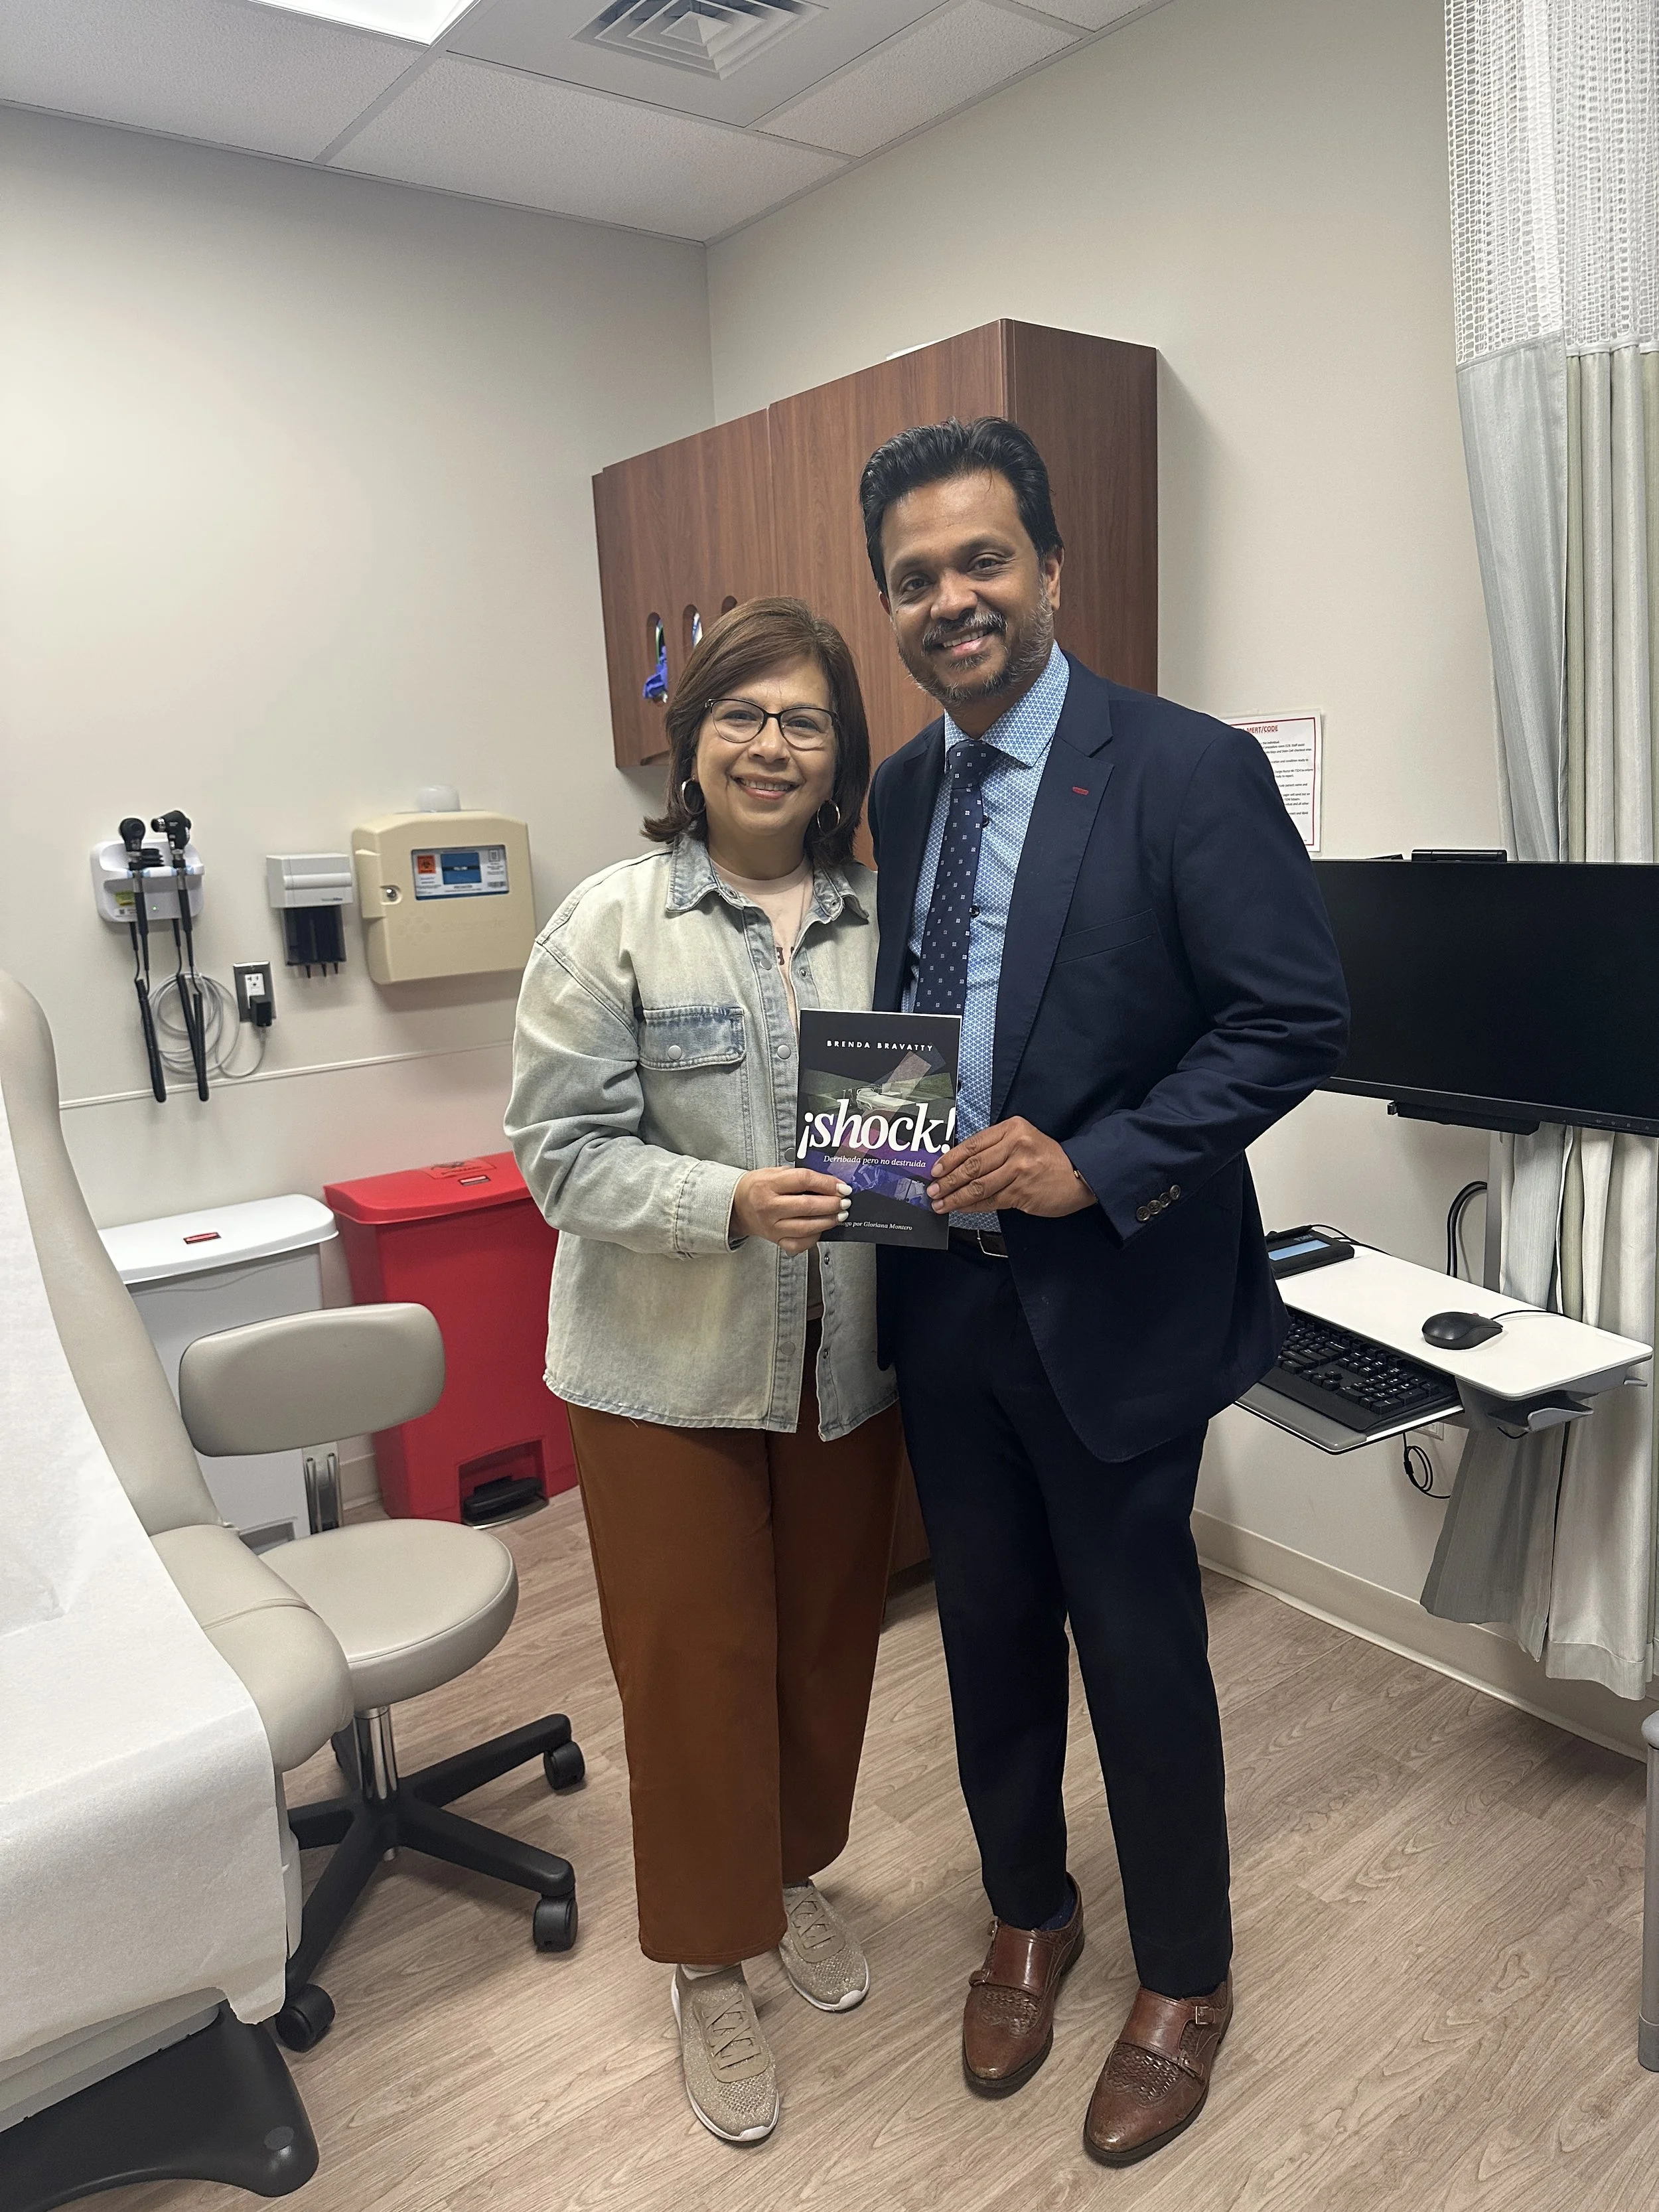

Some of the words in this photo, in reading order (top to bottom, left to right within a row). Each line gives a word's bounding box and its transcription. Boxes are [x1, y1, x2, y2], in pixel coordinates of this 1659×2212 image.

[827, 1039, 871, 1049] BRENDA
[877, 1042, 933, 1052] BRAVATTY
[796, 1098, 956, 1159] ¡shock!
[823, 1155, 861, 1163] Derribada
[891, 1159, 926, 1168] destruida
